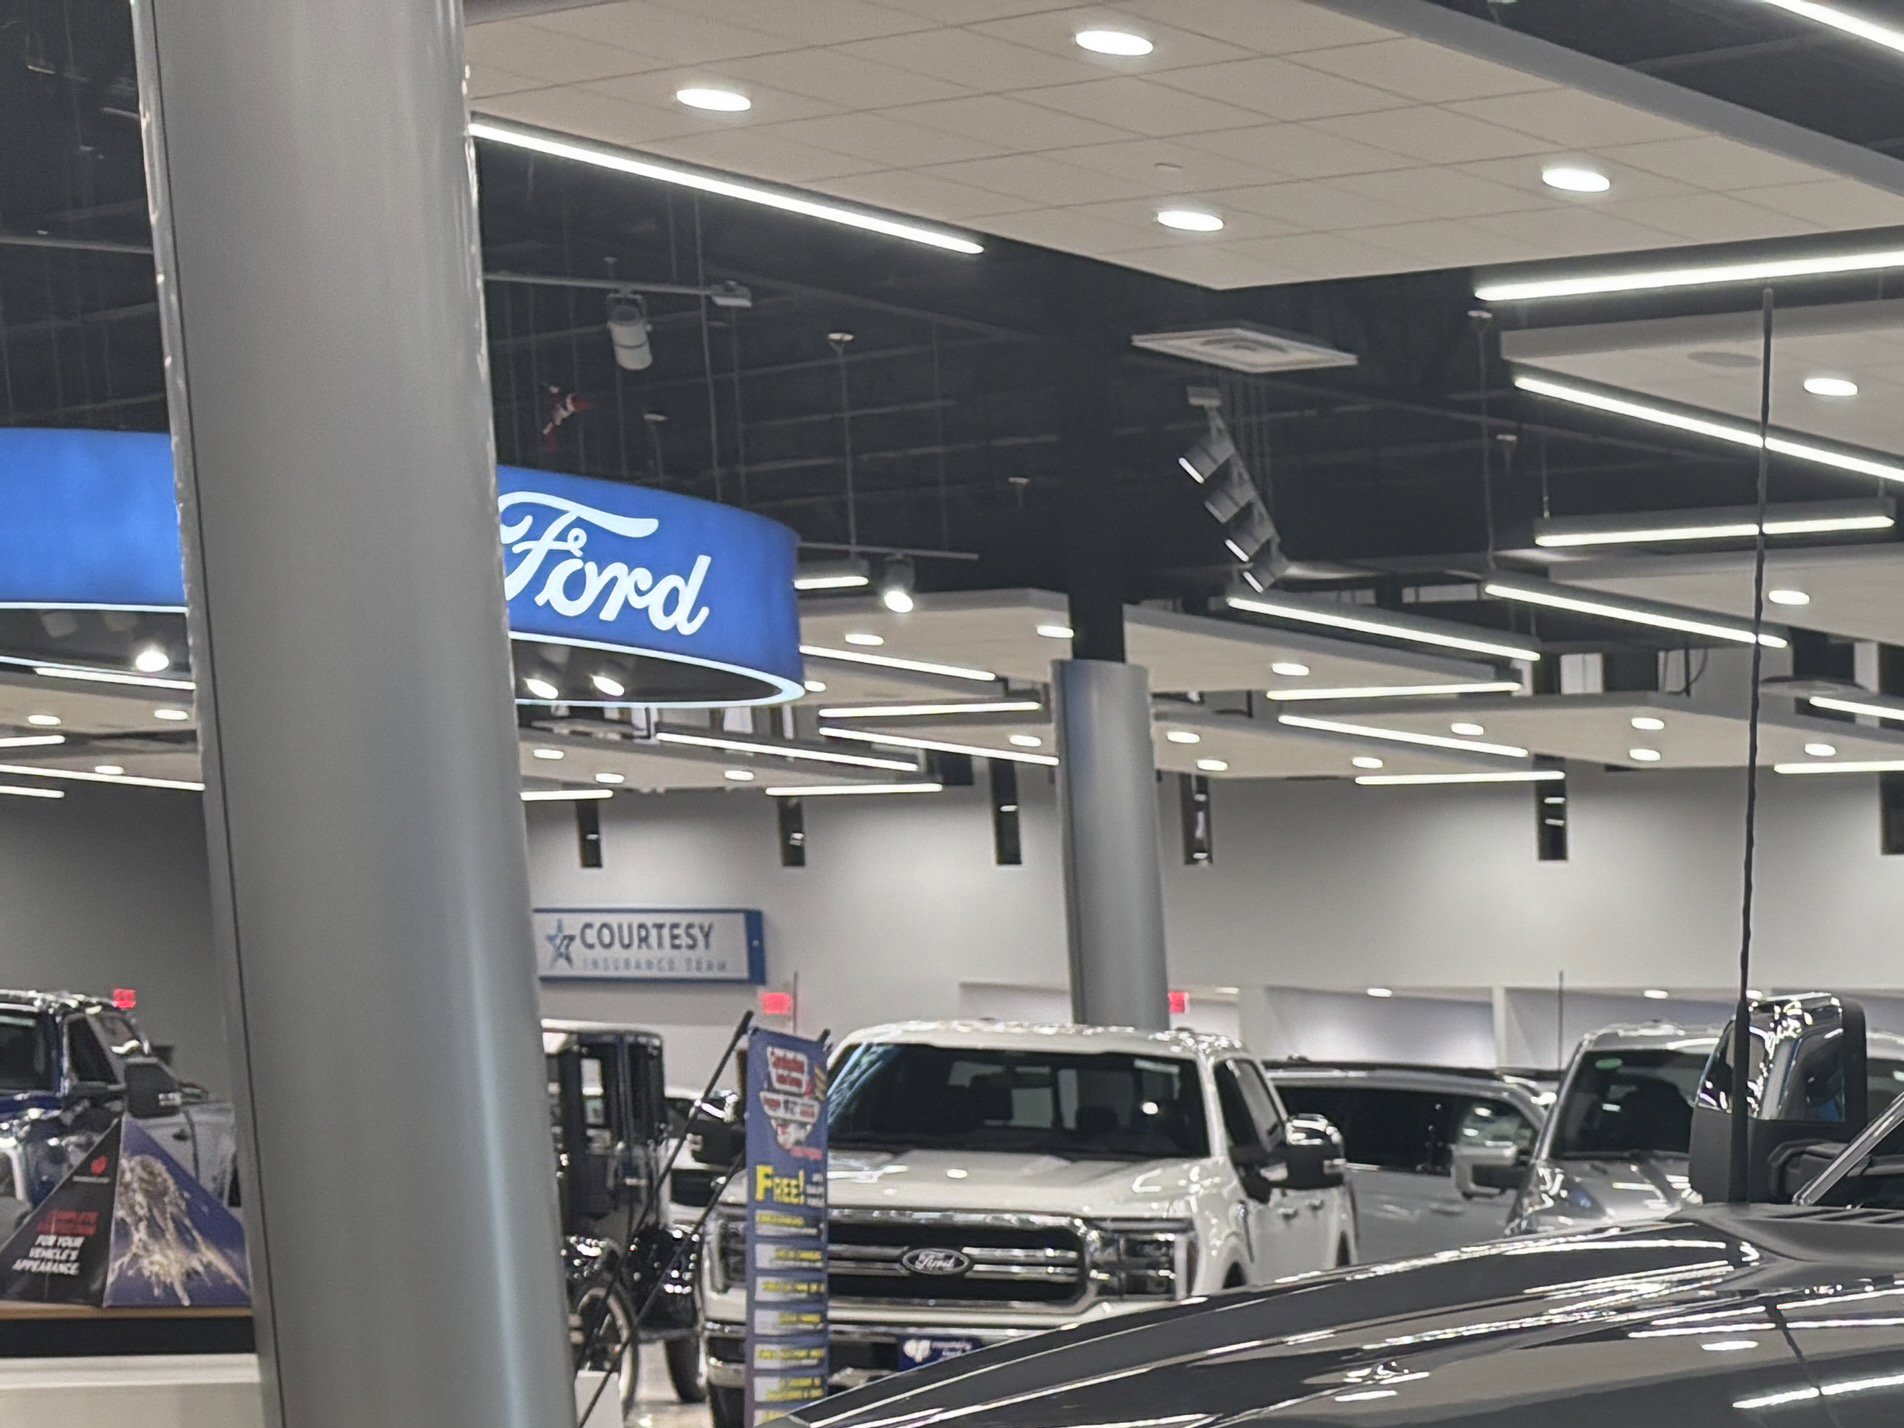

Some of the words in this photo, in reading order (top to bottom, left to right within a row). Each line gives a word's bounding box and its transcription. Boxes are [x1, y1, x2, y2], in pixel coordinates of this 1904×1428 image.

[498, 491, 712, 636] Ford
[580, 922, 714, 950] COURTESY
[35, 1234, 56, 1247] FOR
[57, 1236, 85, 1248] YOUR
